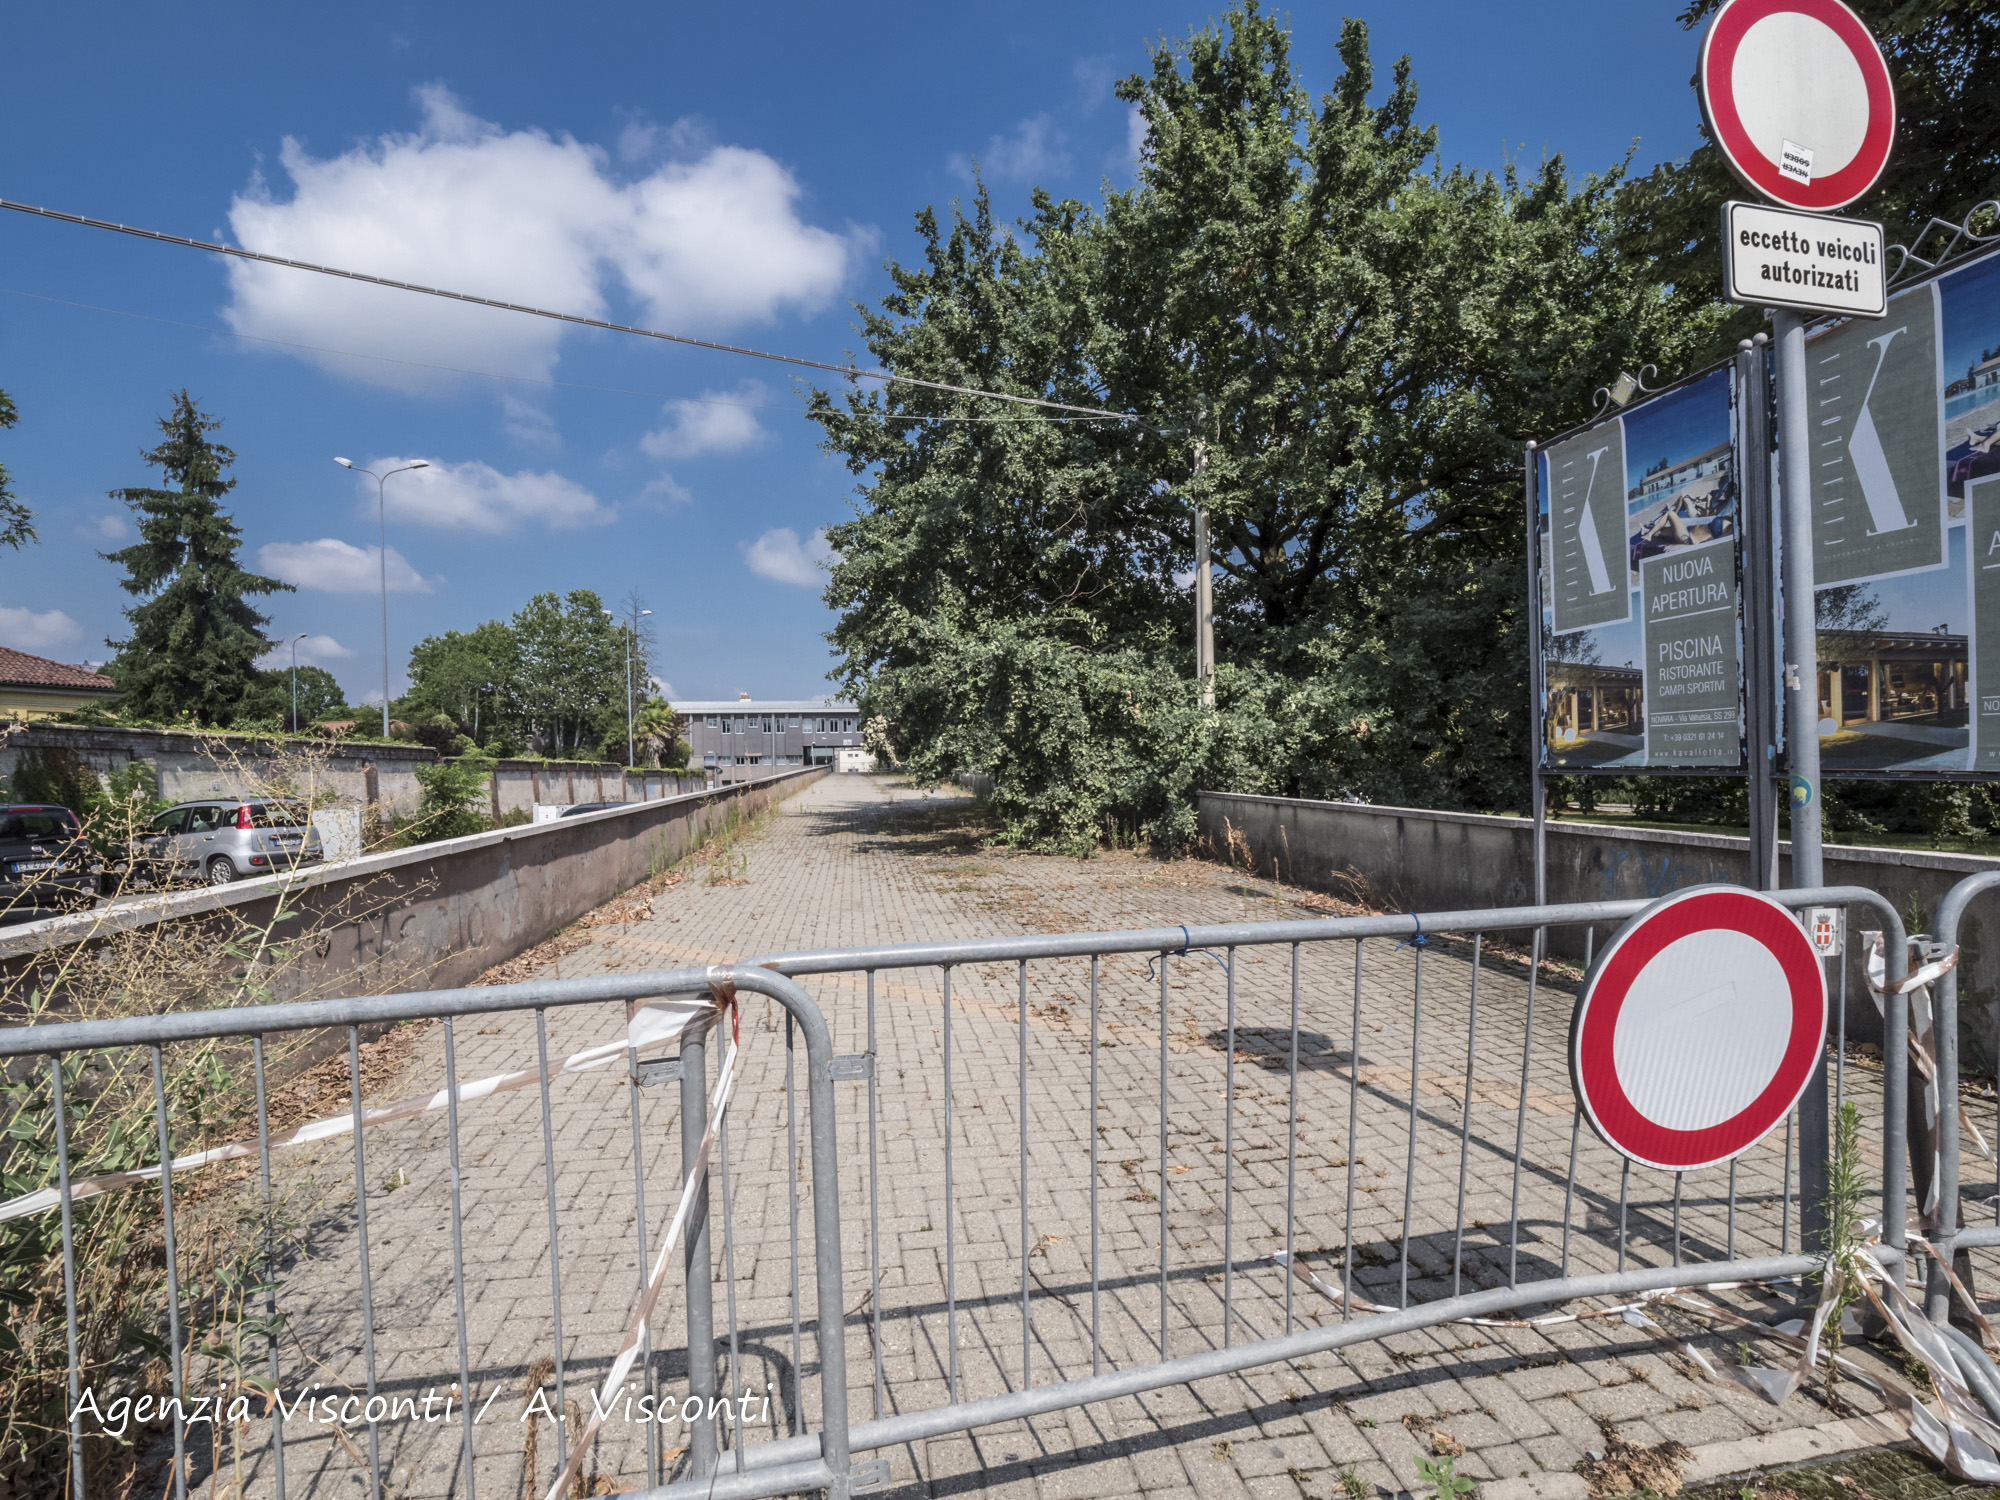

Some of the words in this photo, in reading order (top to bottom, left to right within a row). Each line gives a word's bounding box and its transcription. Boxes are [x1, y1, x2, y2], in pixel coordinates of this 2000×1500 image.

[1782, 163, 1809, 178] NEVER
[1783, 152, 1810, 168] SOBER
[1740, 230, 1810, 255] eccetto
[1816, 237, 1876, 265] veicoli
[1760, 260, 1859, 292] autorizzati
[1663, 556, 1713, 584] NUOVA
[1651, 581, 1728, 614] APERTURA
[1659, 634, 1723, 662] PISCINA
[1659, 660, 1724, 681] RISTORANTE
[1659, 684, 1685, 697] CAMPI
[1687, 679, 1725, 694] SPORTIVI
[1650, 714, 1674, 724] NOVARA
[1679, 713, 1688, 722] Via
[1714, 711, 1723, 720] SS
[1724, 710, 1736, 720] 299
[1671, 733, 1682, 742] +39
[1683, 732, 1697, 741] 0321
[1699, 732, 1706, 741] 61
[1708, 732, 1715, 740] 24
[1718, 731, 1724, 740] 14
